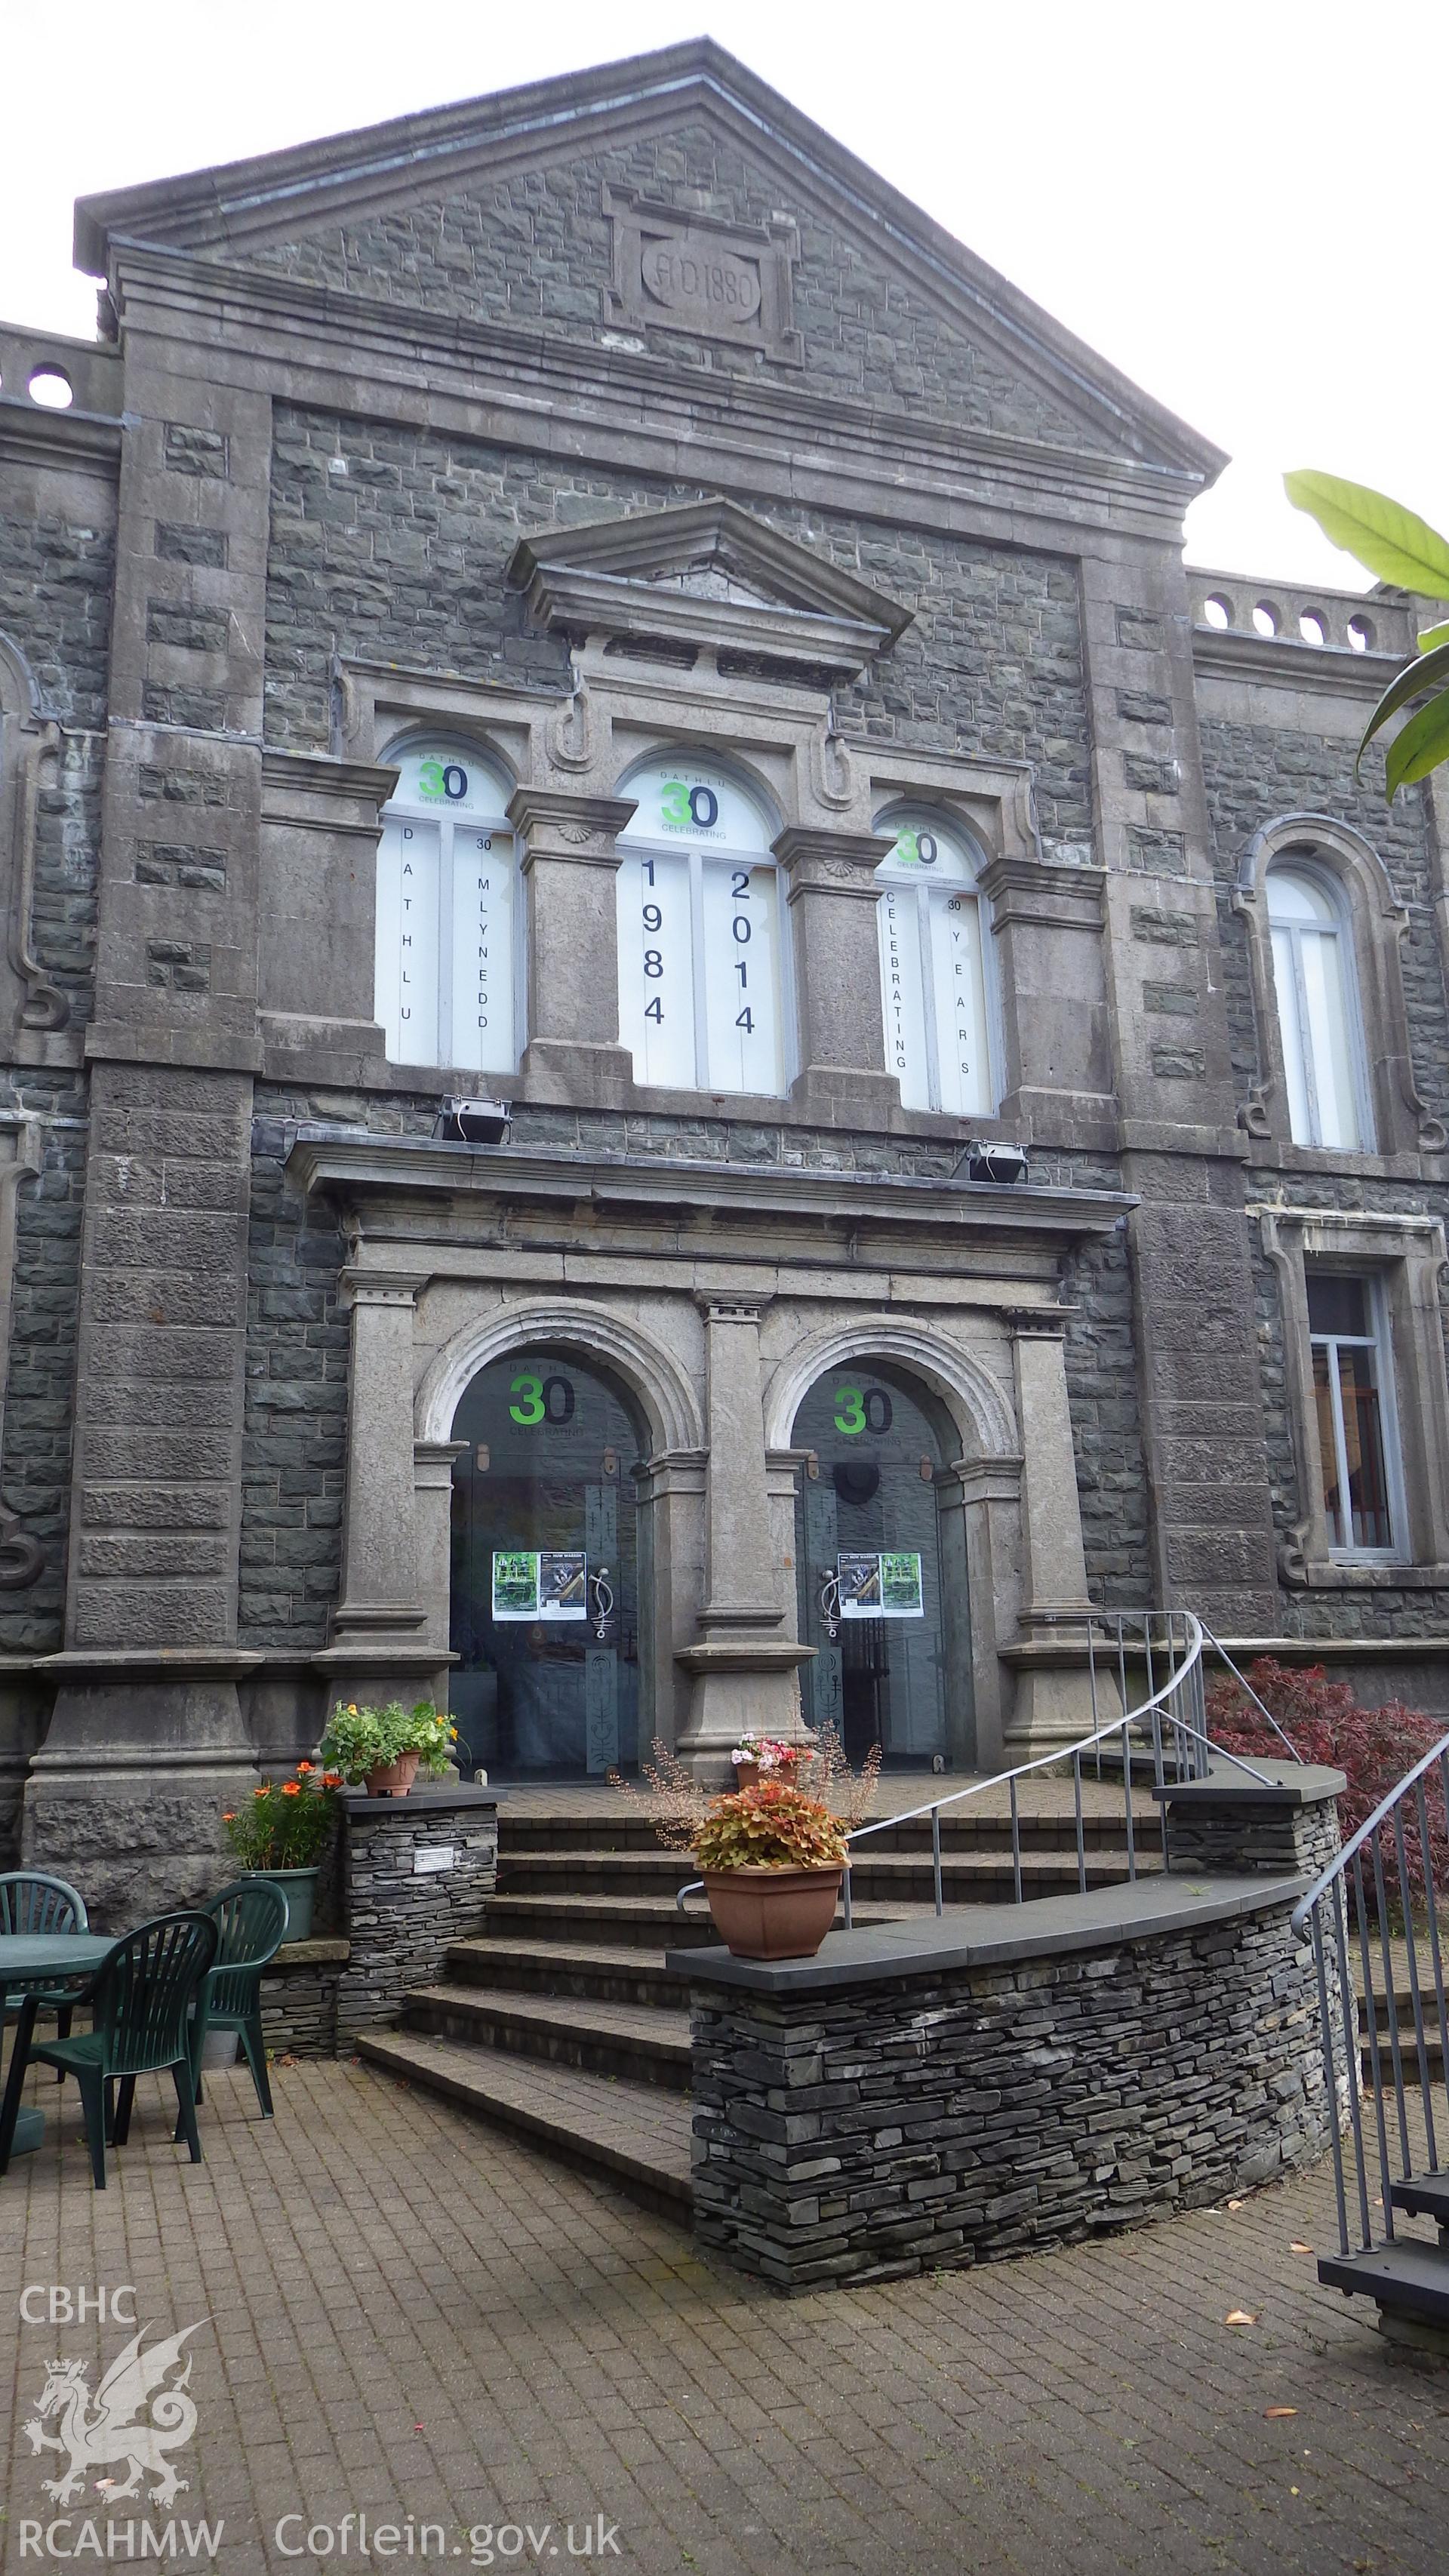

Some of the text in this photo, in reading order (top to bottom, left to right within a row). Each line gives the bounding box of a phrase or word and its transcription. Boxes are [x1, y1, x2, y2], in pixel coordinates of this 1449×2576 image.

[419, 753, 475, 768] DATHLU
[419, 762, 468, 799] 30
[660, 771, 725, 787] DATHLU
[419, 796, 475, 810] CELEBRATING
[661, 782, 718, 828] 30
[661, 824, 727, 839] CELEBRATING
[897, 829, 937, 864] 30
[897, 861, 944, 873] CELEBRATING
[401, 828, 414, 1020] DATHLU
[476, 839, 491, 1027] 30 MLYNEDD
[641, 860, 664, 1024] 1984
[731, 871, 755, 1034] 2014
[886, 892, 906, 1068] CELEBRATING
[948, 900, 969, 1073] 30 YEARS
[509, 1374, 575, 1425] 30
[834, 1386, 893, 1435] 30
